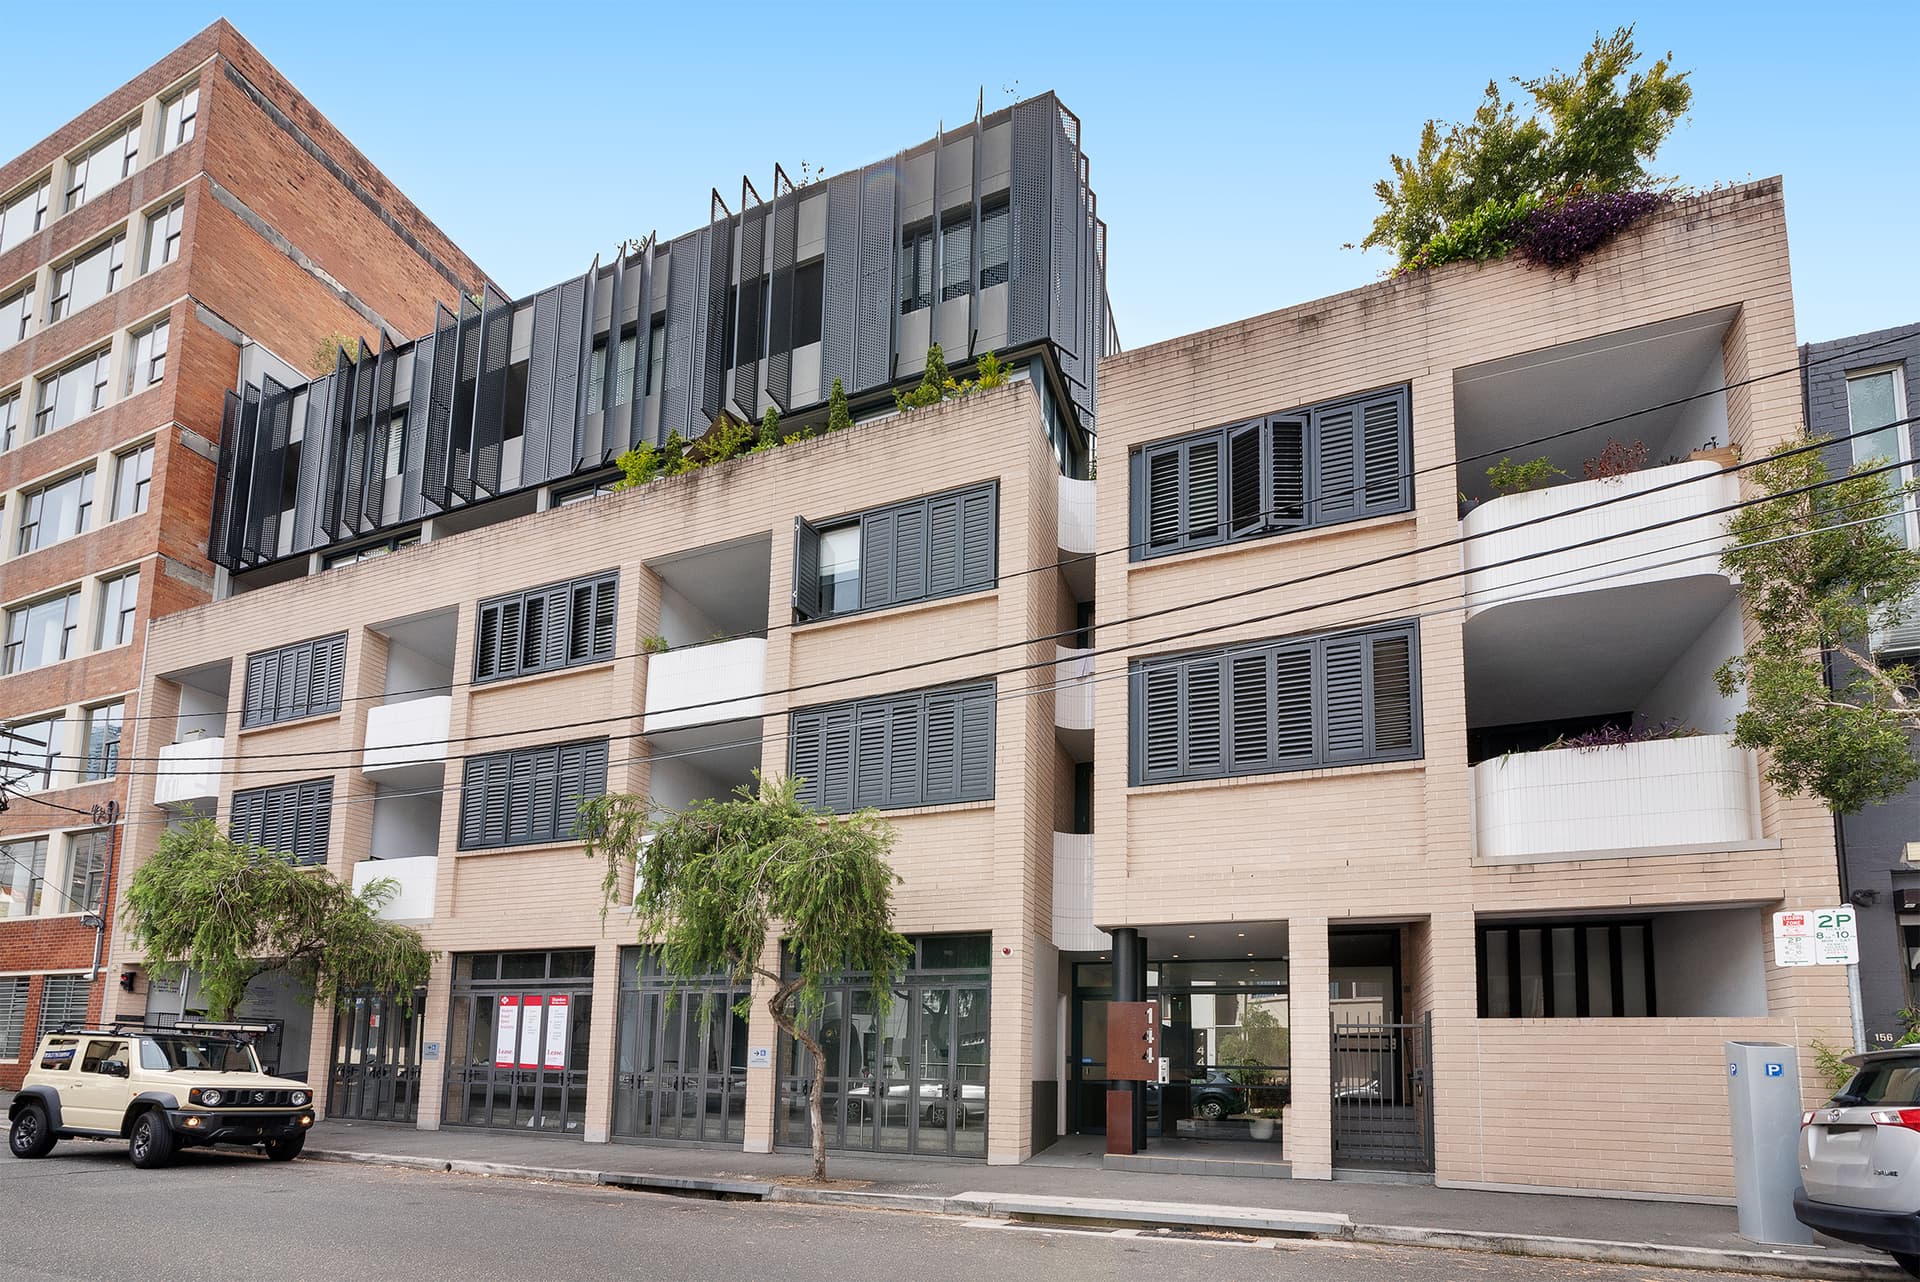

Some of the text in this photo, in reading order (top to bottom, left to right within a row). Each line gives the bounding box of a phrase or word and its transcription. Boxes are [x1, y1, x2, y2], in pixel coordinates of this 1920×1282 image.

[1818, 914, 1851, 928] 2P
[1874, 1033, 1894, 1042] 156
[1730, 1064, 1737, 1075] P
[1767, 1064, 1780, 1076] P
